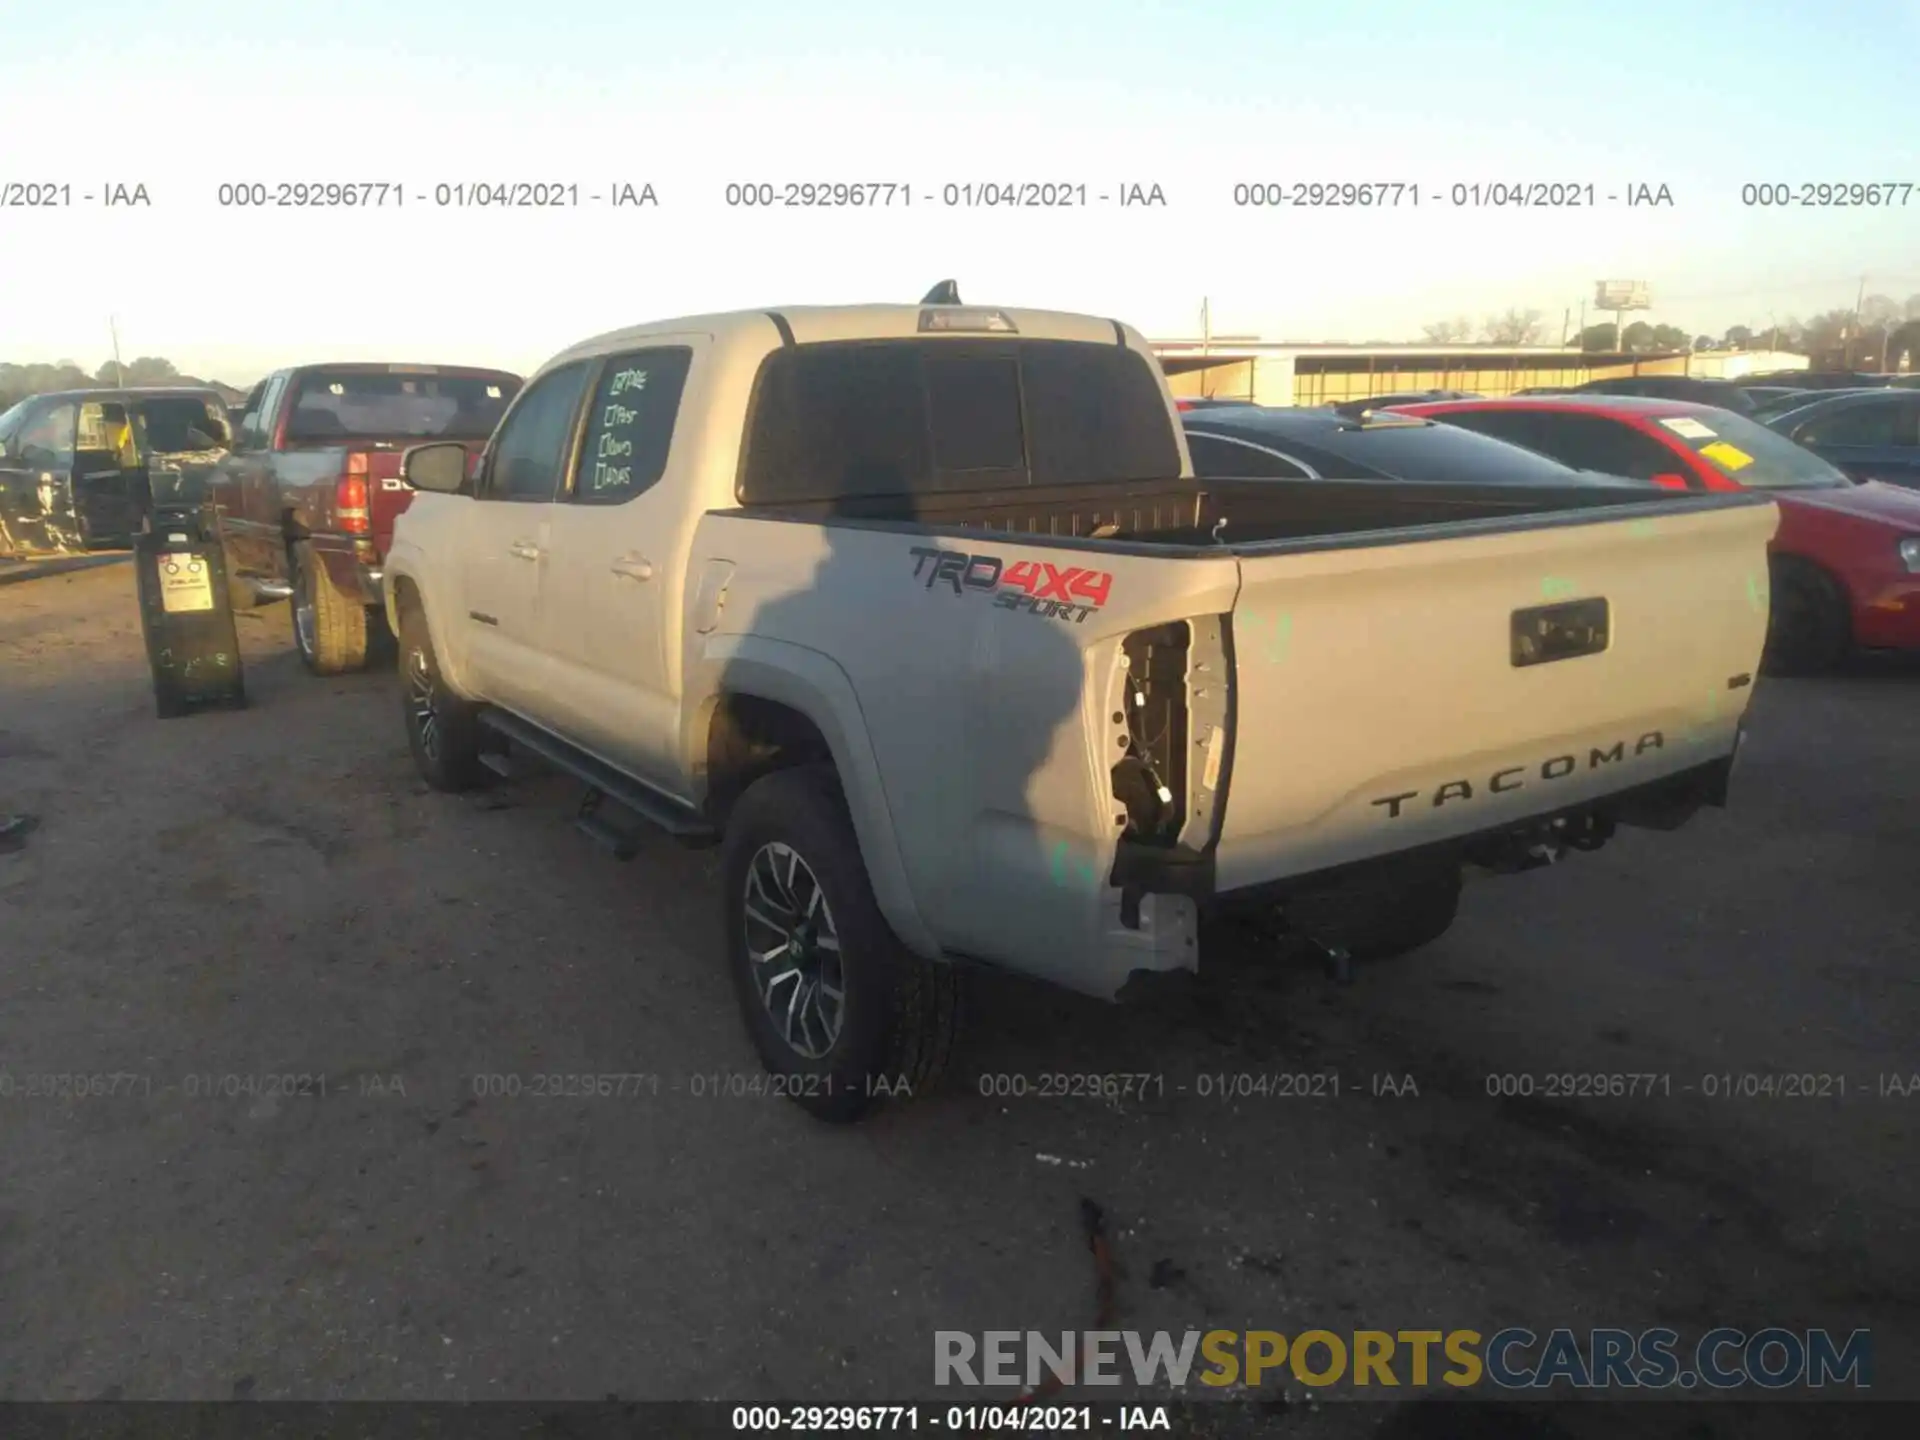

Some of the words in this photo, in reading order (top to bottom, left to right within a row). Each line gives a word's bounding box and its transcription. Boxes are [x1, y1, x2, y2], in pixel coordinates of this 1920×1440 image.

[909, 546, 1002, 597] TRD
[993, 590, 1099, 624] SPORT
[1370, 729, 1665, 819] TACOMA
